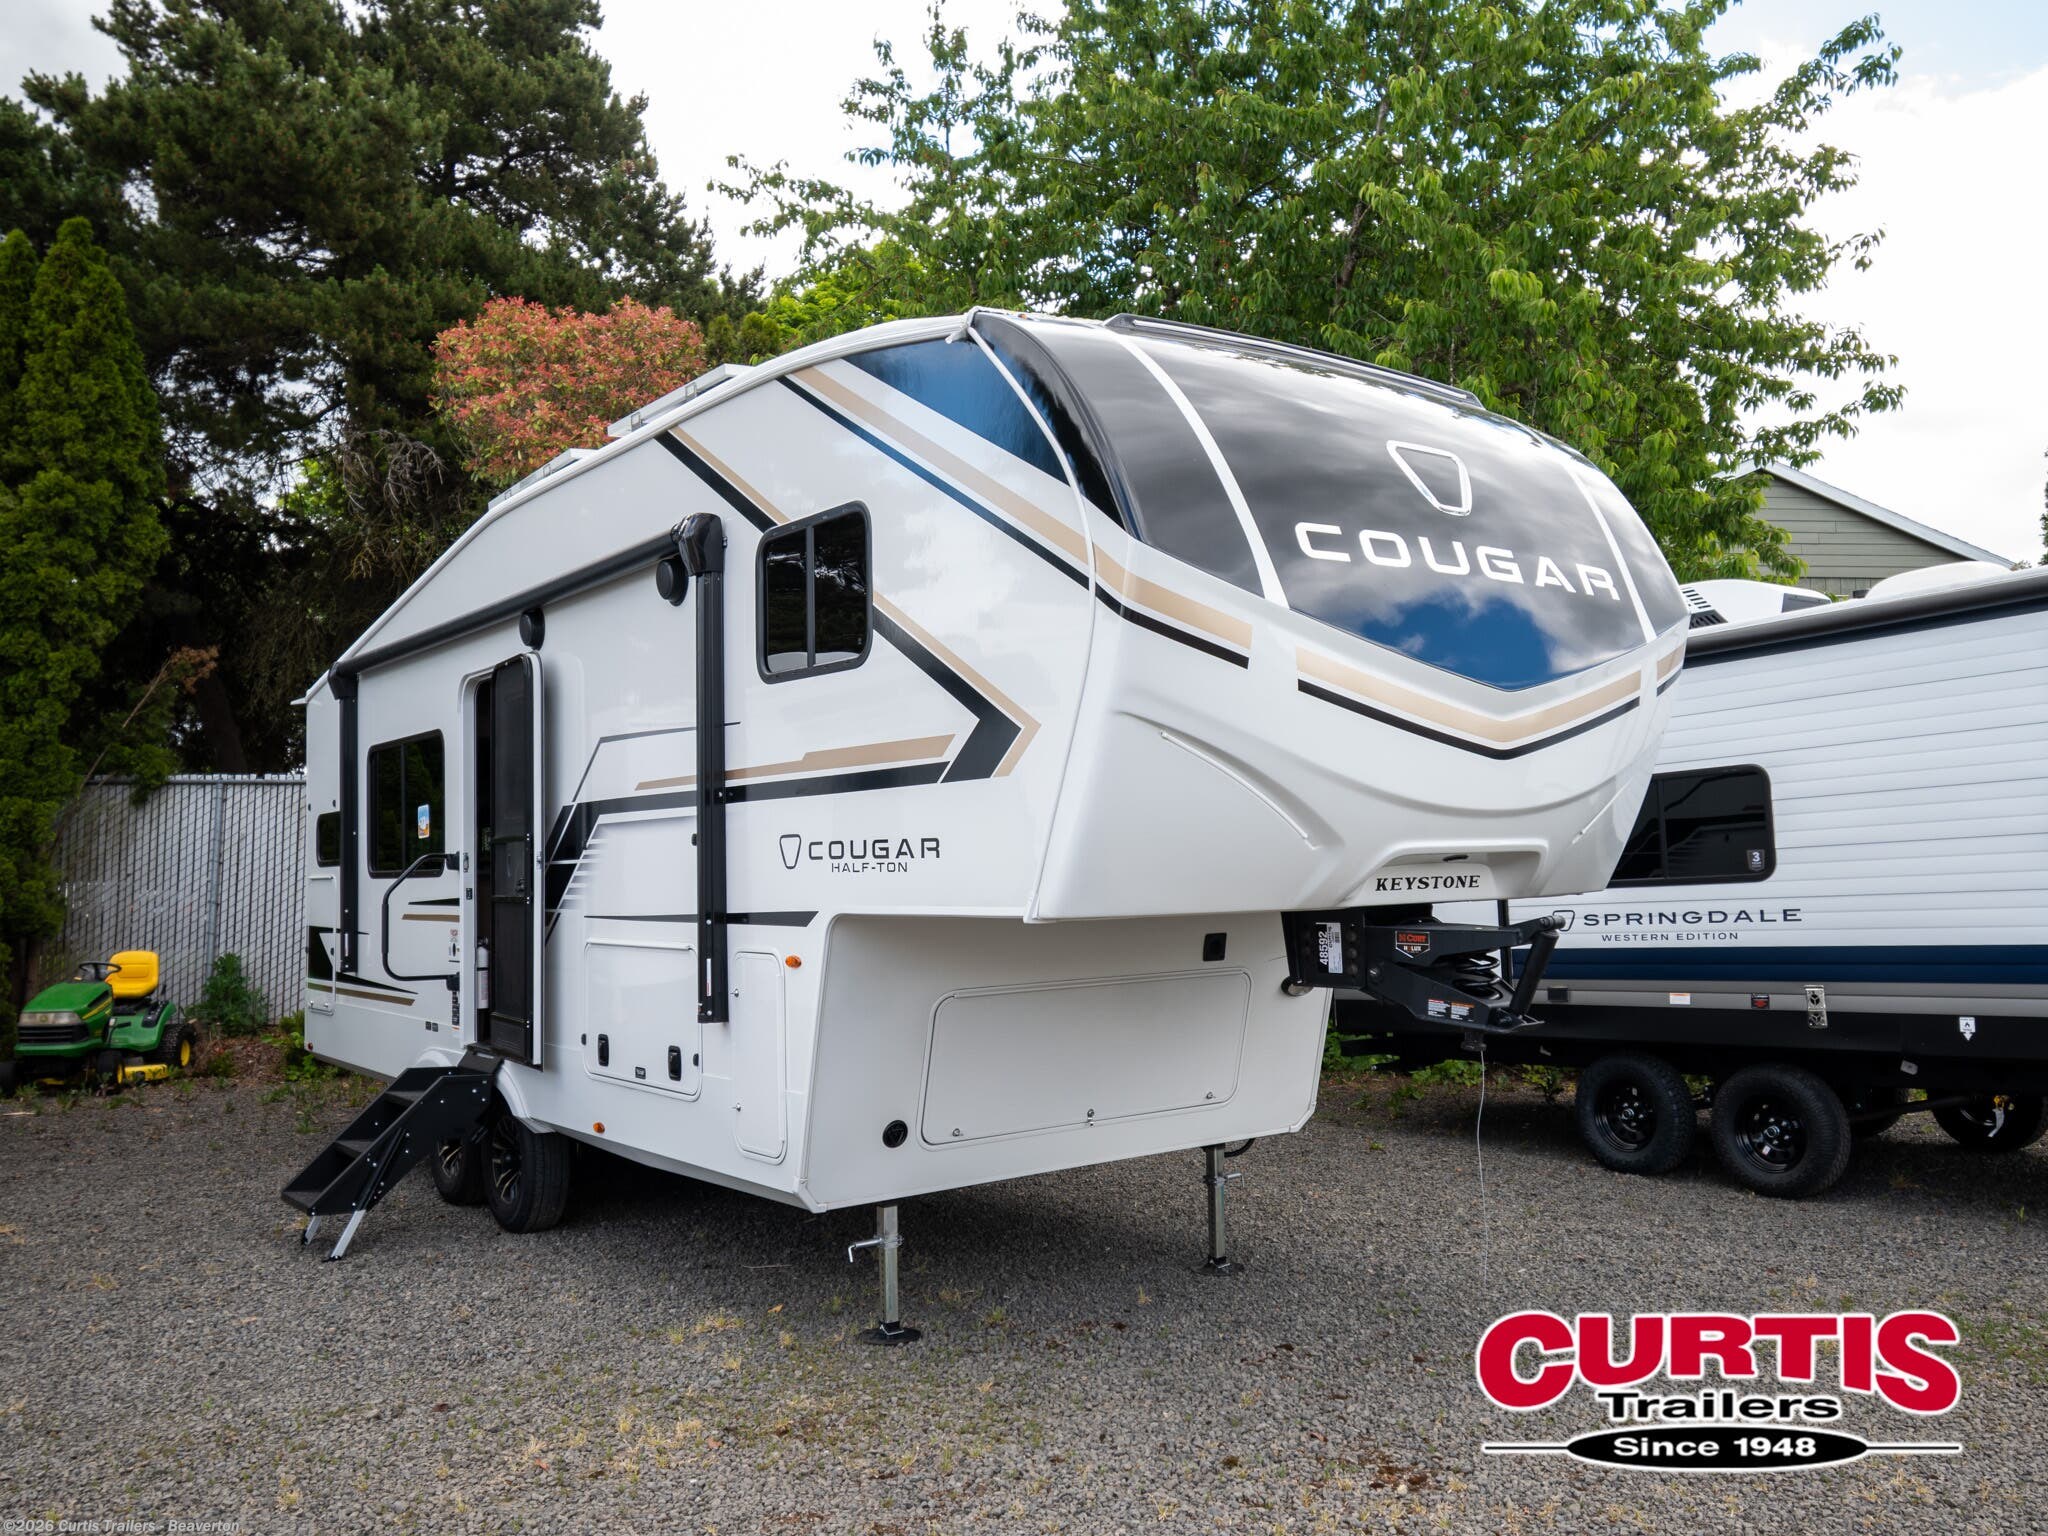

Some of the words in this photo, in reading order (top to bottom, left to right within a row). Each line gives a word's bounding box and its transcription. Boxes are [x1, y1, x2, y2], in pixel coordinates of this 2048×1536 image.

[1295, 522, 1621, 600] COUGAR
[808, 838, 941, 860] COUGAR
[1752, 851, 1761, 862] 3
[831, 862, 908, 873] HALF-TON
[1375, 875, 1481, 891] KEYSTONE
[1583, 908, 1803, 927] SPRINGDALE
[1601, 933, 1670, 942] WESTERN
[1676, 931, 1739, 942] EDITION
[1318, 931, 1329, 965] 48592
